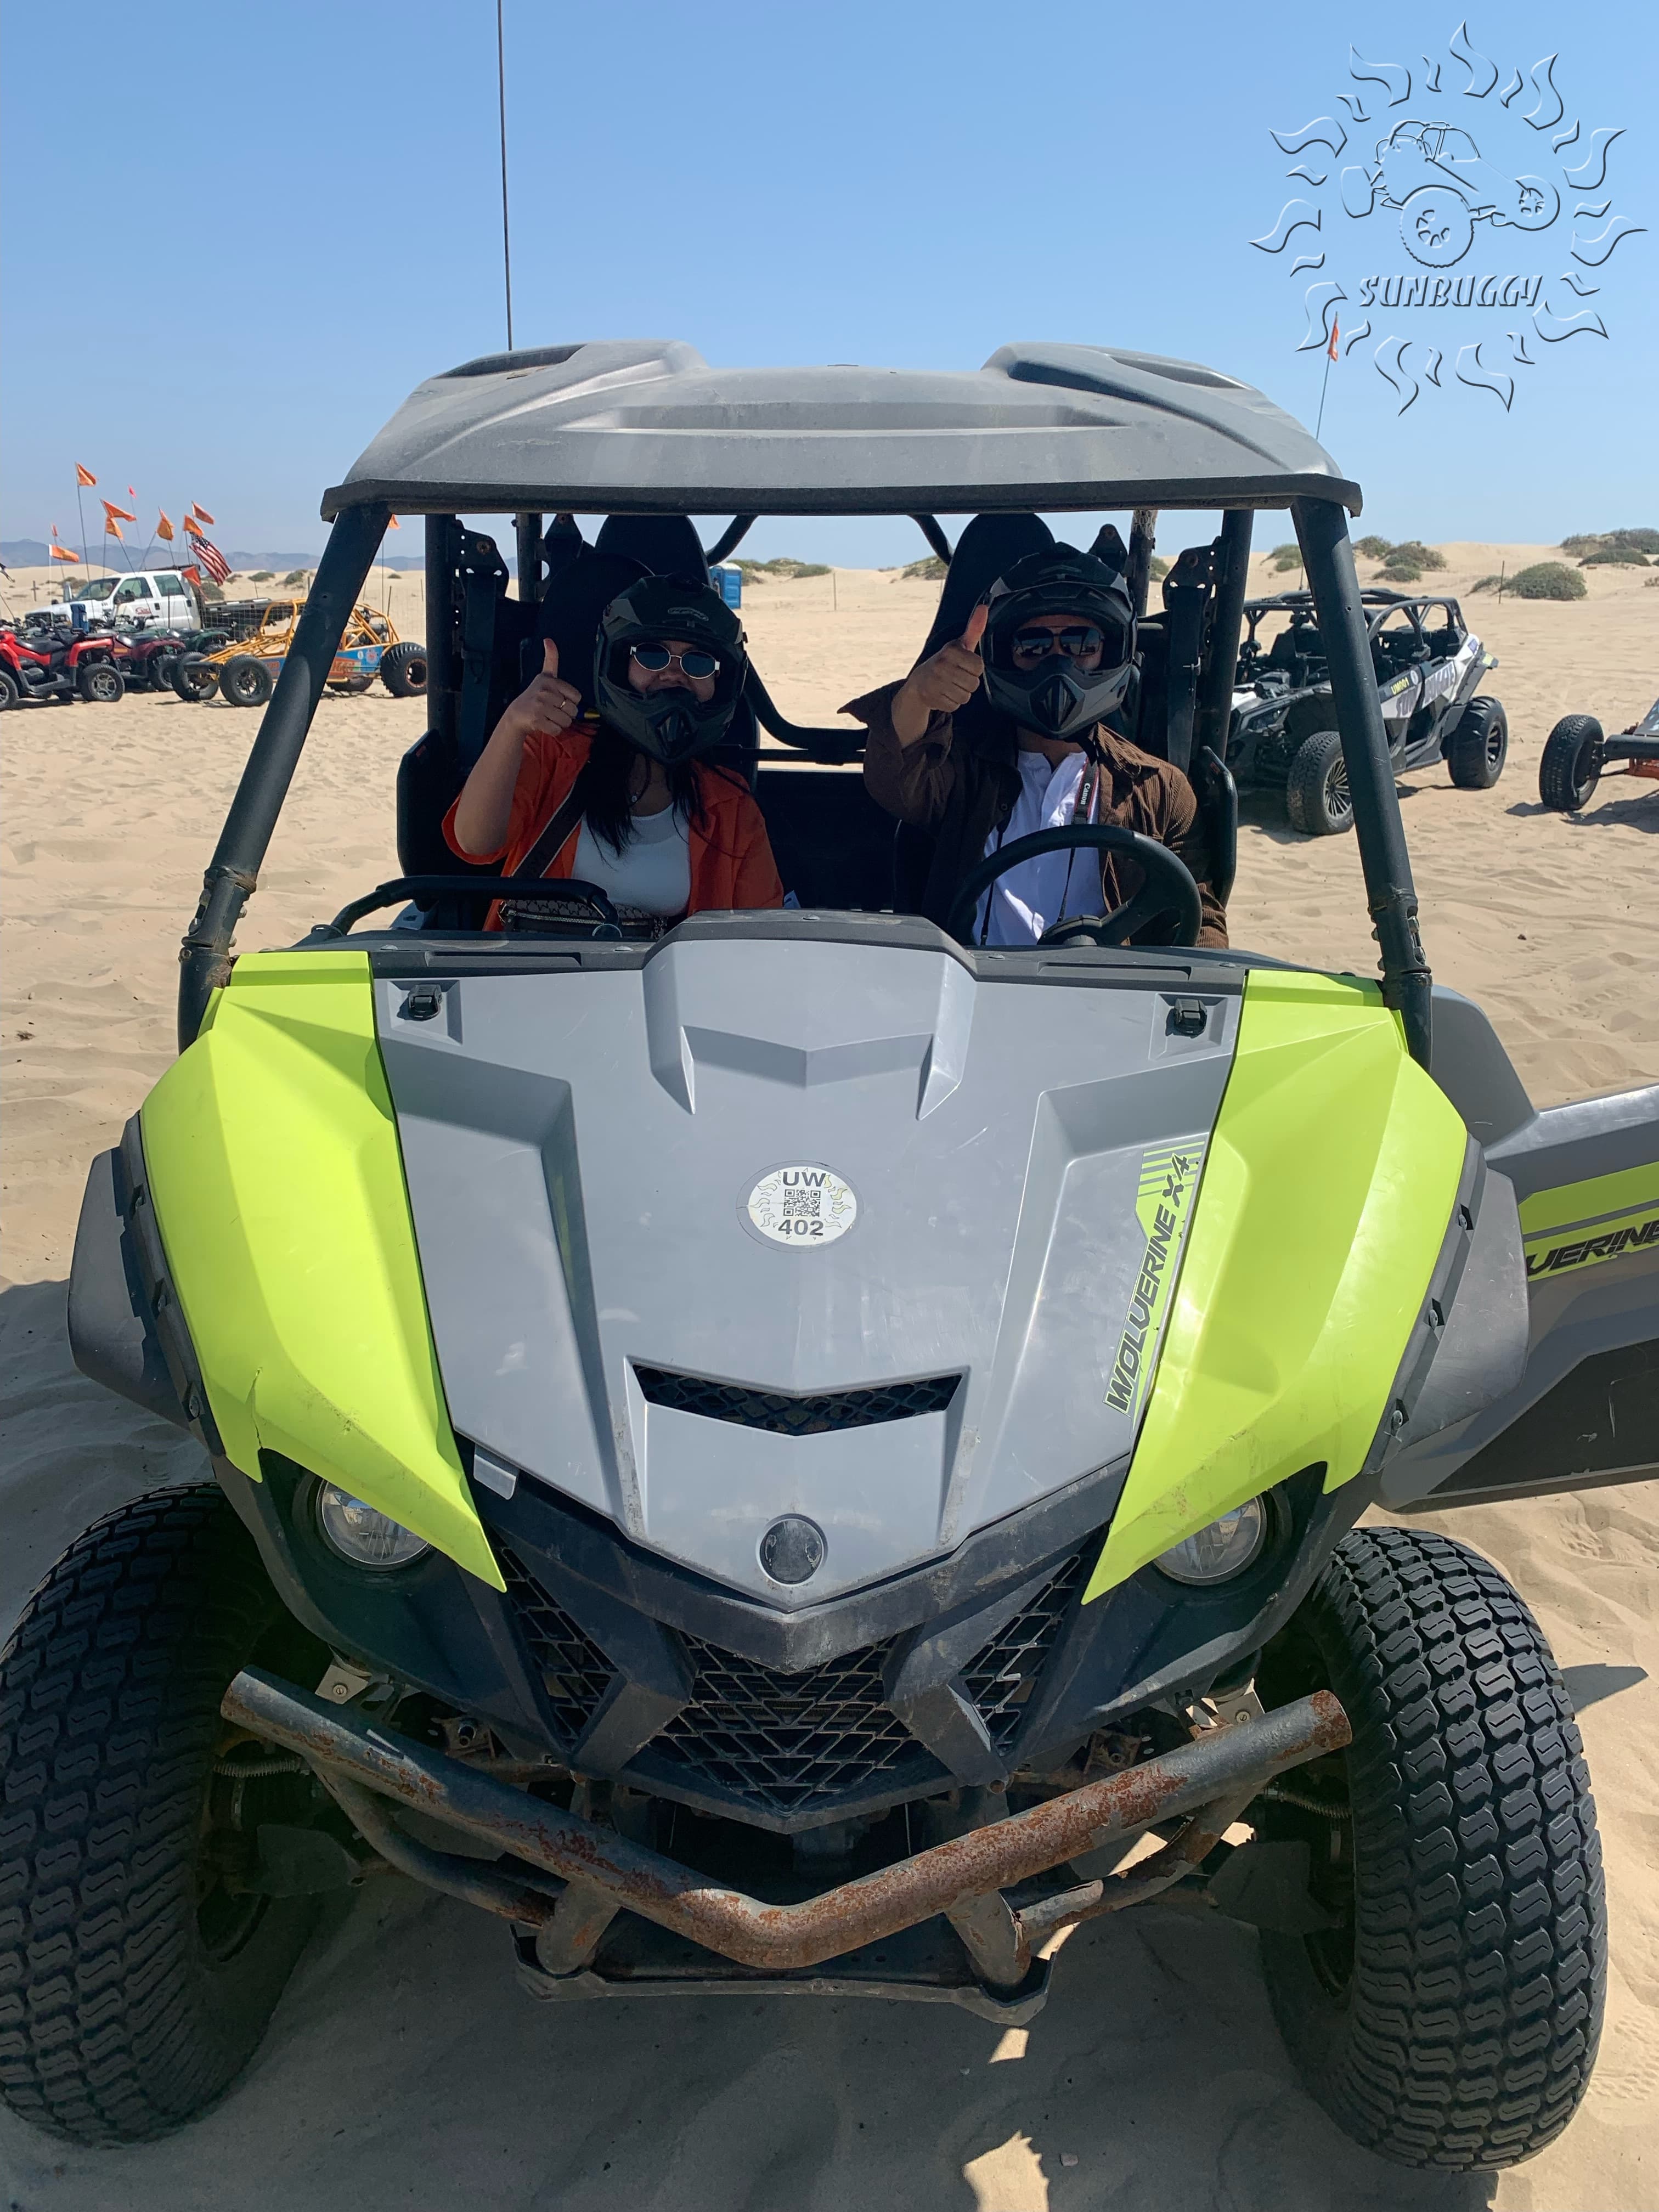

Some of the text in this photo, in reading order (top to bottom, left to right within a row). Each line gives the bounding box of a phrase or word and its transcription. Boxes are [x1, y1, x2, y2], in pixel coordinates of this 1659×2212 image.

[1080, 783, 1091, 805] Canon
[783, 1171, 826, 1187] UW
[778, 1219, 824, 1237] 402
[1105, 1154, 1190, 1412] WOLVERINE X4
